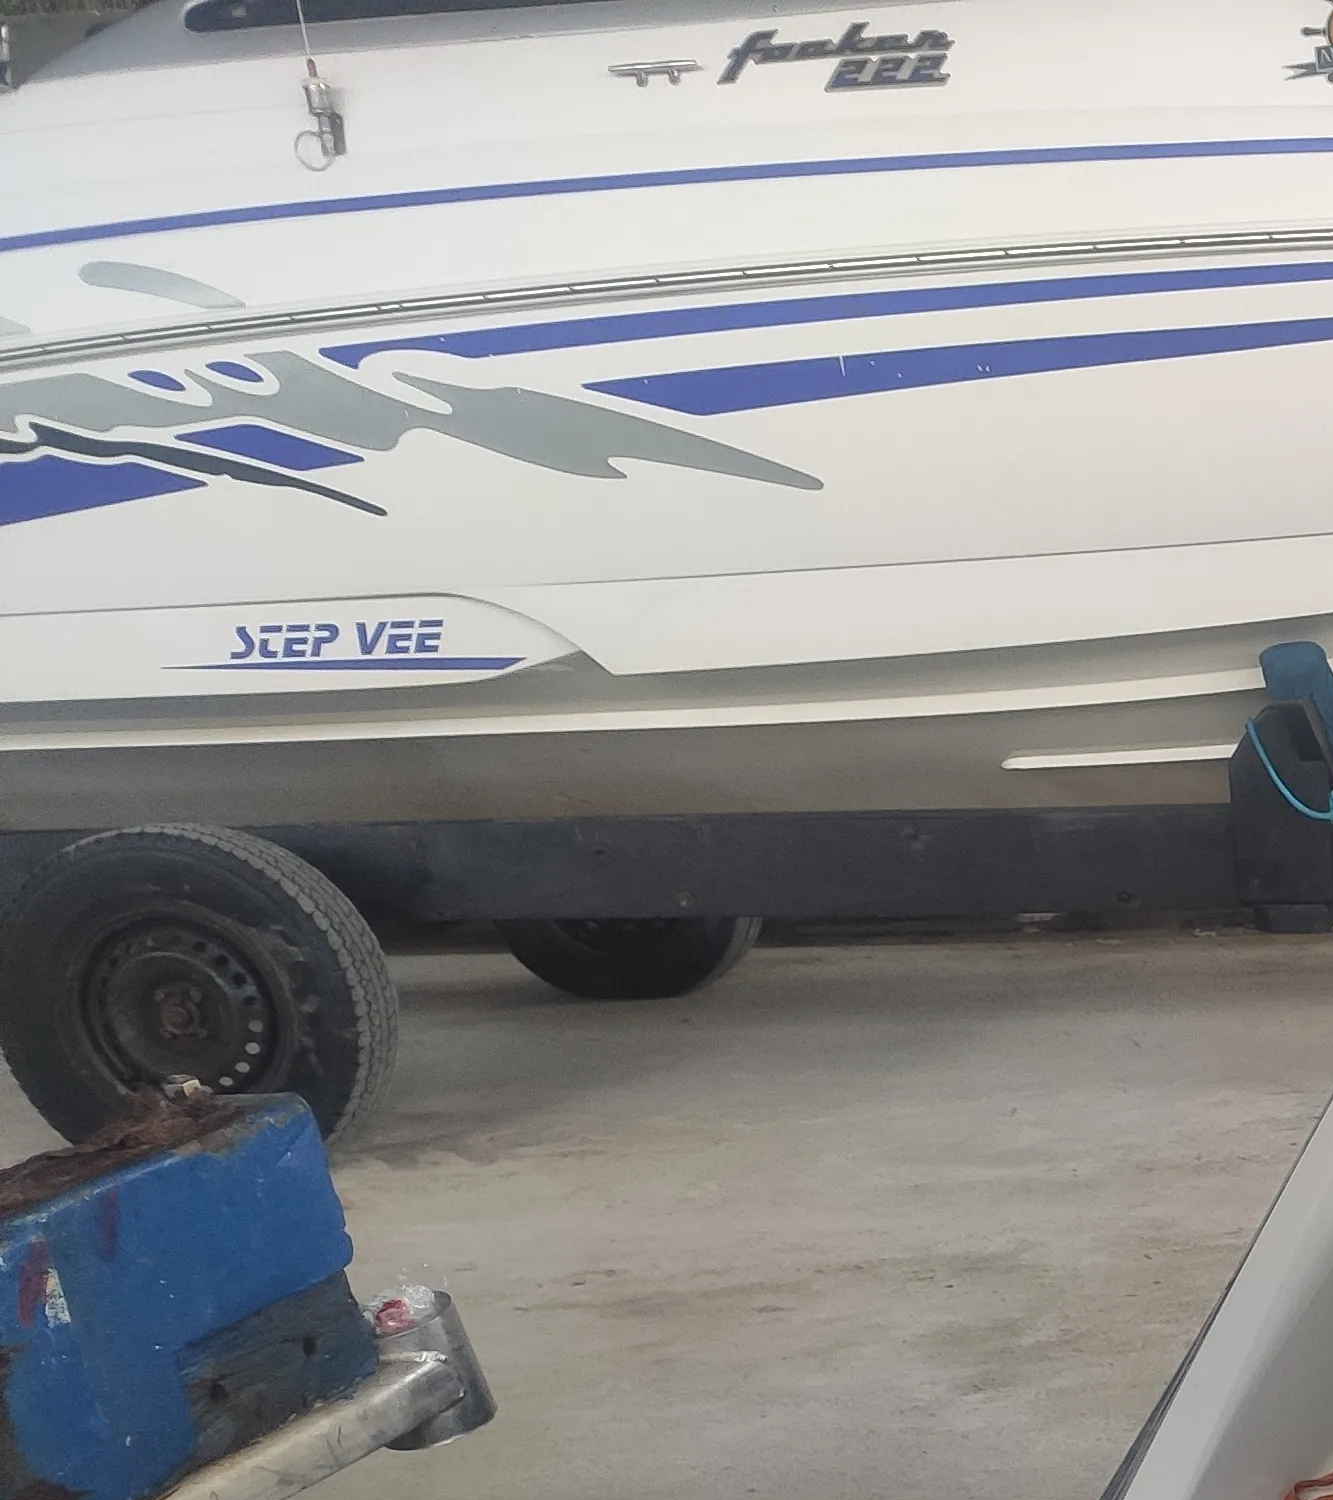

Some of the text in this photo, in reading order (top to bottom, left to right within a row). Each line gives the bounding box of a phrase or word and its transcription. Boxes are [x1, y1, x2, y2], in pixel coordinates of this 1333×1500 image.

[824, 52, 951, 93] 222
[229, 618, 444, 660] STEP VEE
